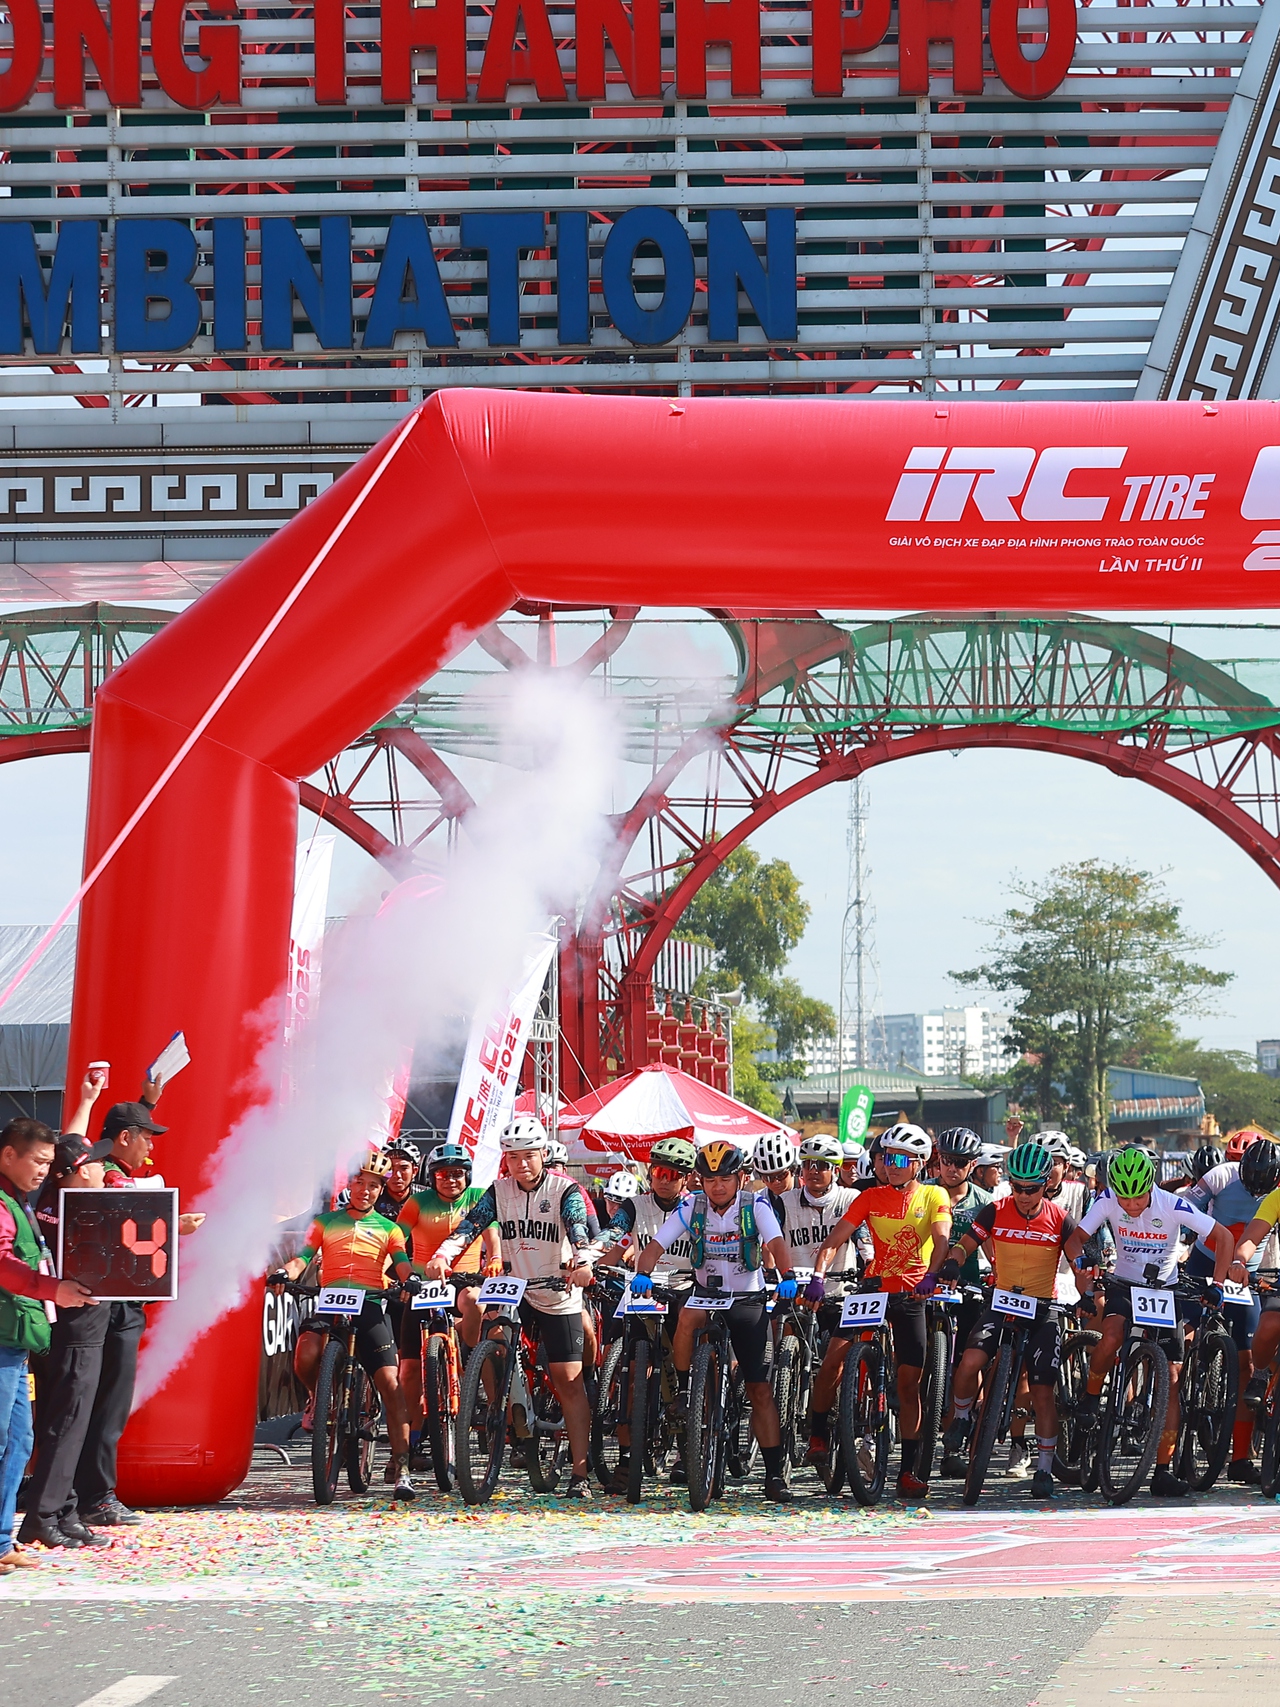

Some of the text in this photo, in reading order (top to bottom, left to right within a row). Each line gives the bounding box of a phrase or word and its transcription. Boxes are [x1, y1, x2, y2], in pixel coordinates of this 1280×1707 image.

[1119, 473, 1216, 522] TIRE
[914, 536, 931, 547] VÔ
[934, 537, 962, 549] ĐỊCH
[964, 538, 980, 547] XE
[981, 538, 1006, 549] ĐẠP
[1007, 538, 1027, 549] ĐỊA
[1029, 536, 1058, 547] HÌNH
[1060, 538, 1101, 547] PHONG
[1104, 536, 1135, 547] TRÀO
[1137, 536, 1169, 547] TOÀN
[1170, 535, 1205, 547] QUỐC
[1099, 554, 1203, 573] LẦN THỨ II
[497, 1013, 521, 1086] 2025
[993, 1227, 1060, 1243] TREK
[1130, 1231, 1168, 1240] MAXXIS
[121, 1218, 167, 1278] 4
[1121, 1238, 1168, 1248] SHIMANO
[1123, 1246, 1165, 1254] GIANT
[418, 1286, 449, 1299] 304
[485, 1282, 519, 1296] 333
[1224, 1284, 1244, 1296] 02
[324, 1293, 358, 1305] 305
[998, 1295, 1031, 1310] 330
[1138, 1296, 1168, 1314] 317
[848, 1301, 881, 1316] 312
